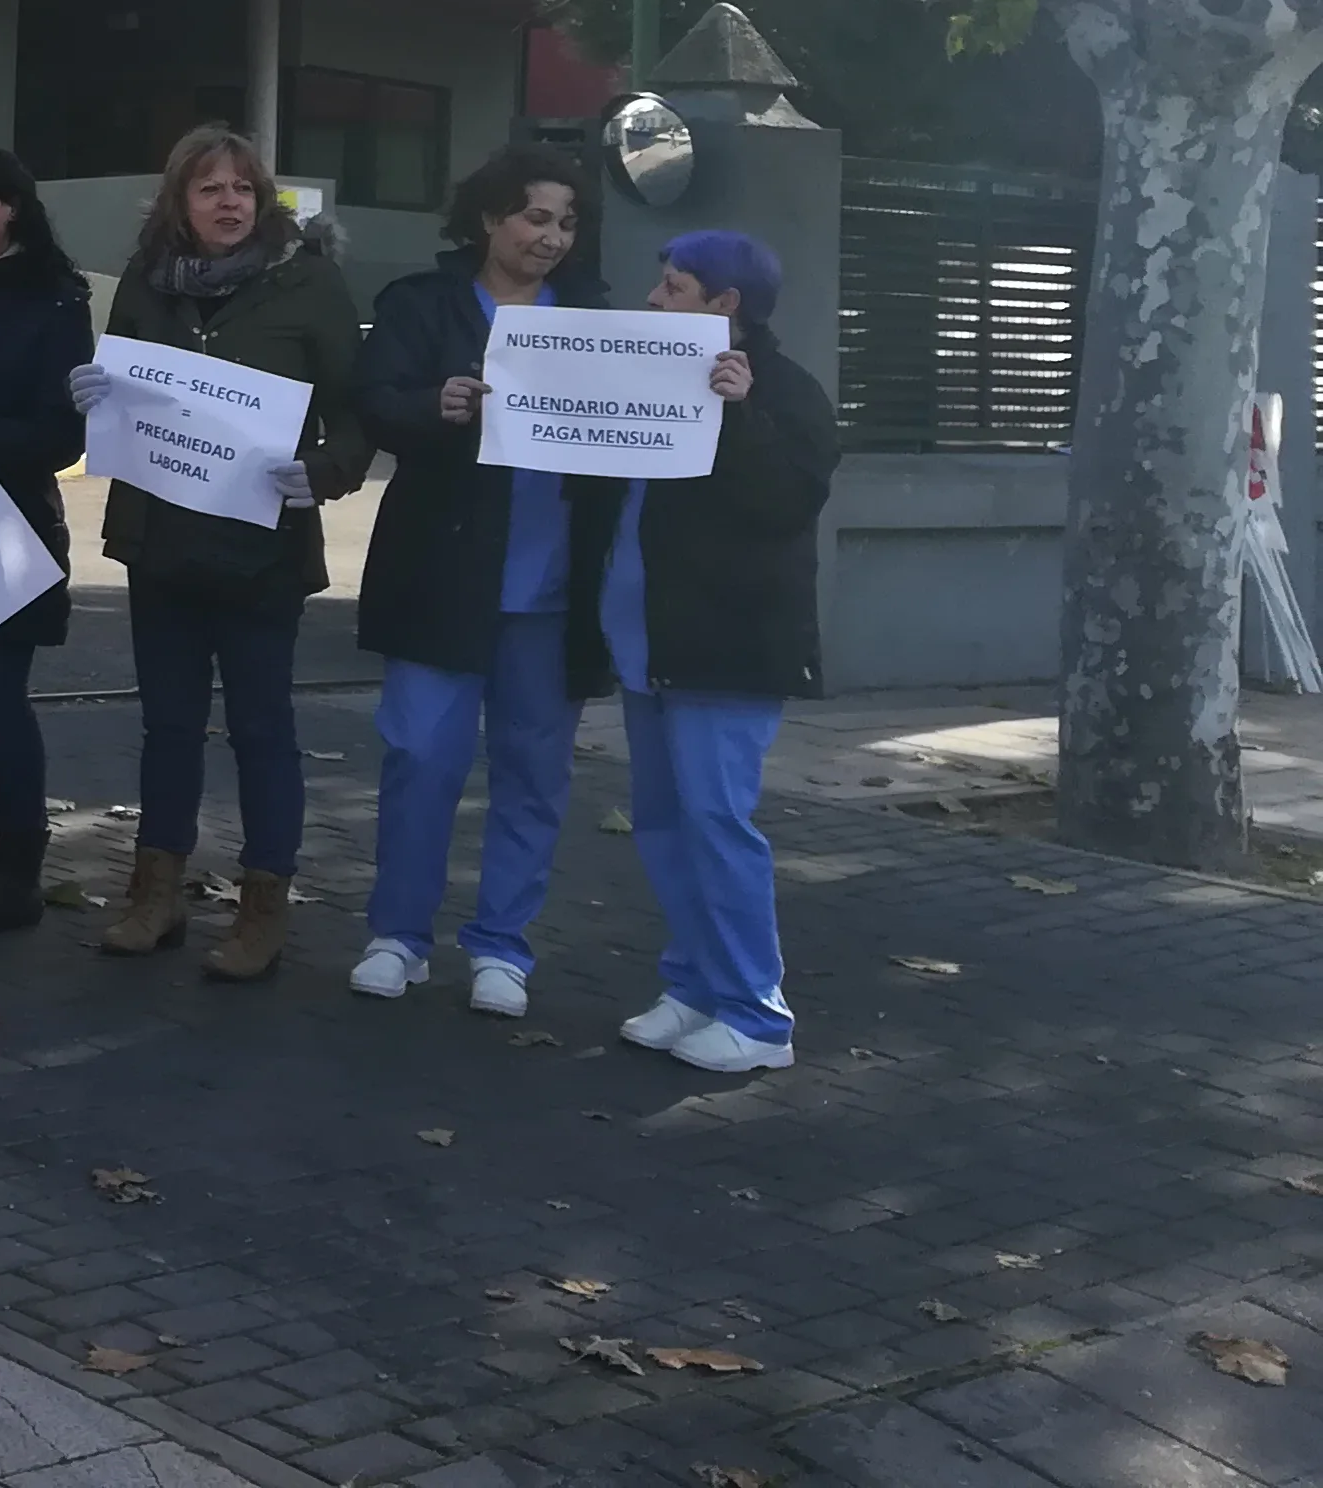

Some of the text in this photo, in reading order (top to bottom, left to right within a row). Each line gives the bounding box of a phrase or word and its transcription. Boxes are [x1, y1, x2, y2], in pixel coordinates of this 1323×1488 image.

[506, 333, 704, 358] NUESTROS DERECHOS:
[129, 364, 173, 386] CLECE
[189, 379, 261, 410] SELECTIA
[506, 393, 704, 419] CALENDARIO ANUAL Y
[135, 420, 236, 461] PRECARIEDAD
[532, 423, 674, 447] PAGA MENSUAL
[149, 450, 211, 483] LABORAL
